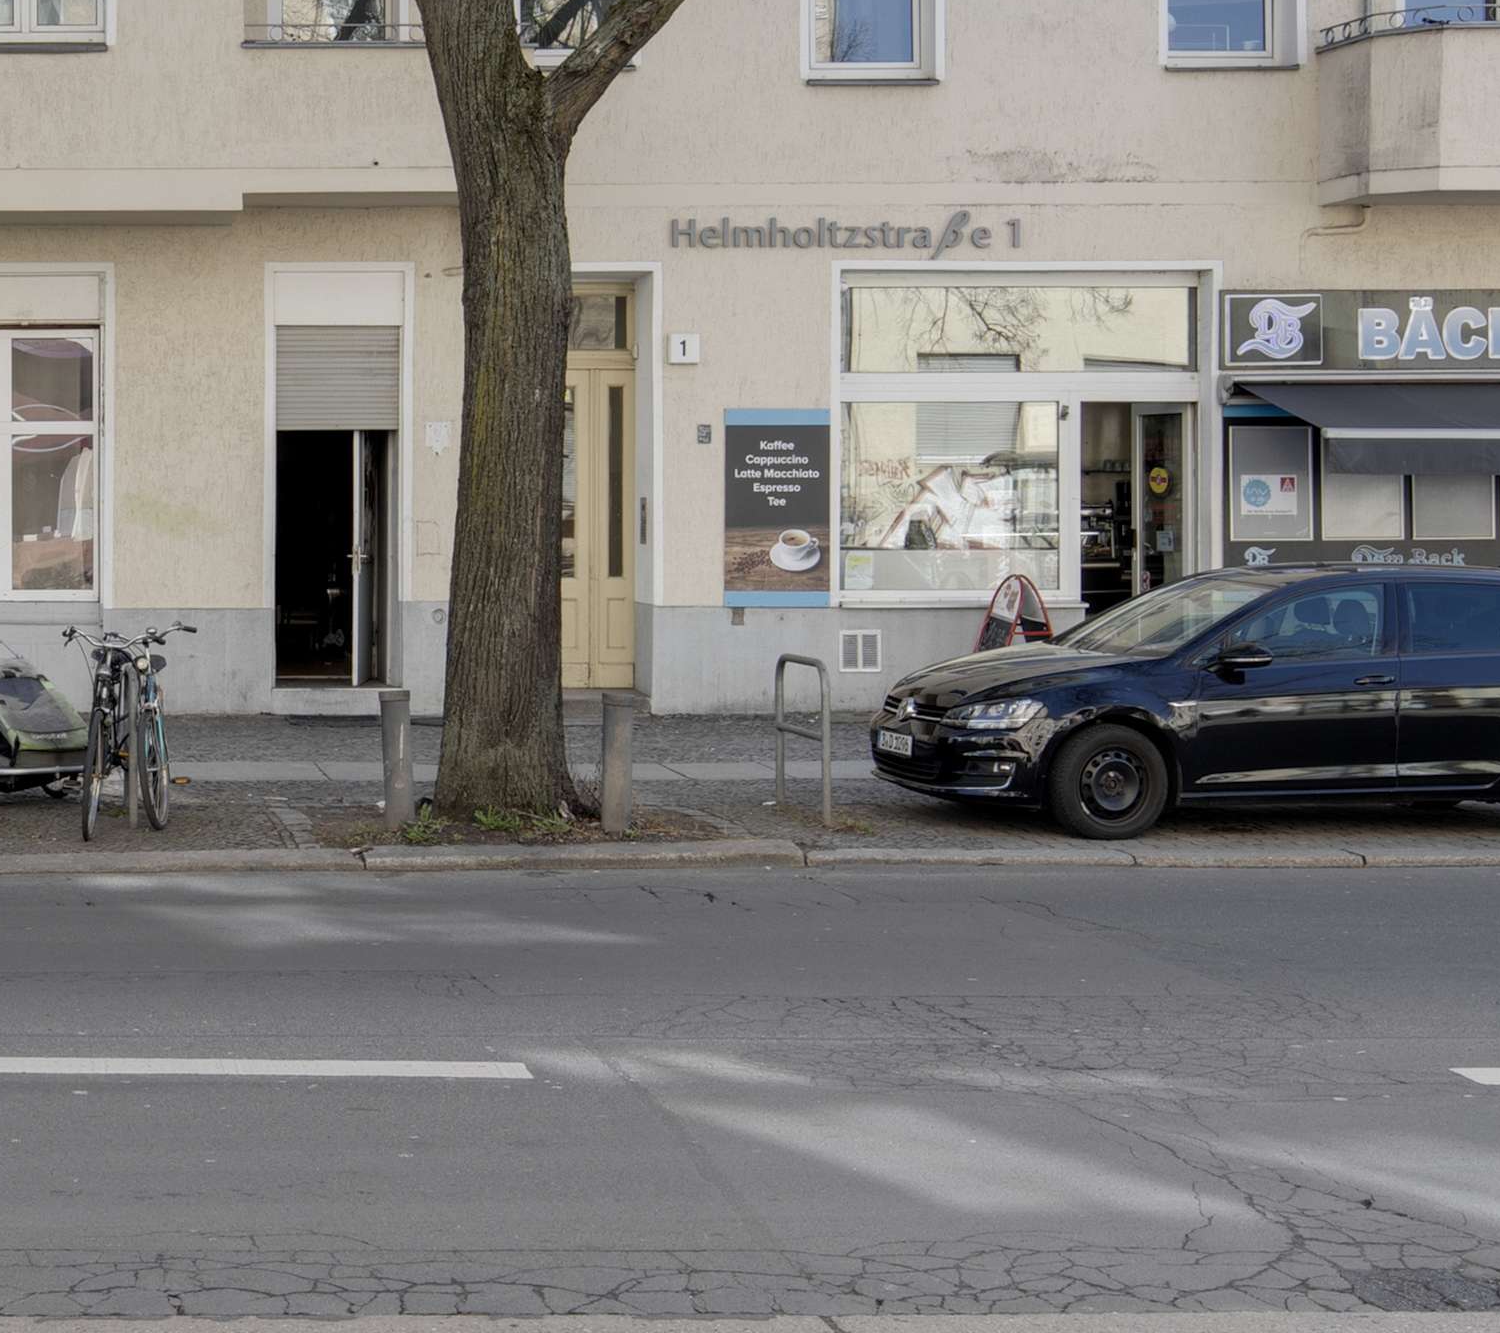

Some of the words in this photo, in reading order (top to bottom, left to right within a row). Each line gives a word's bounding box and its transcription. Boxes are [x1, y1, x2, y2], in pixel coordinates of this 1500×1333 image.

[670, 210, 993, 261] Helmholtzstraße
[1004, 217, 1022, 250] 1
[679, 339, 687, 357] 1
[760, 440, 795, 450] Kaffee
[745, 454, 809, 466] Cappuccino
[734, 468, 762, 478] Latte
[764, 468, 820, 478] Macchiato
[753, 483, 801, 494] Espresso
[767, 496, 787, 506] Tee
